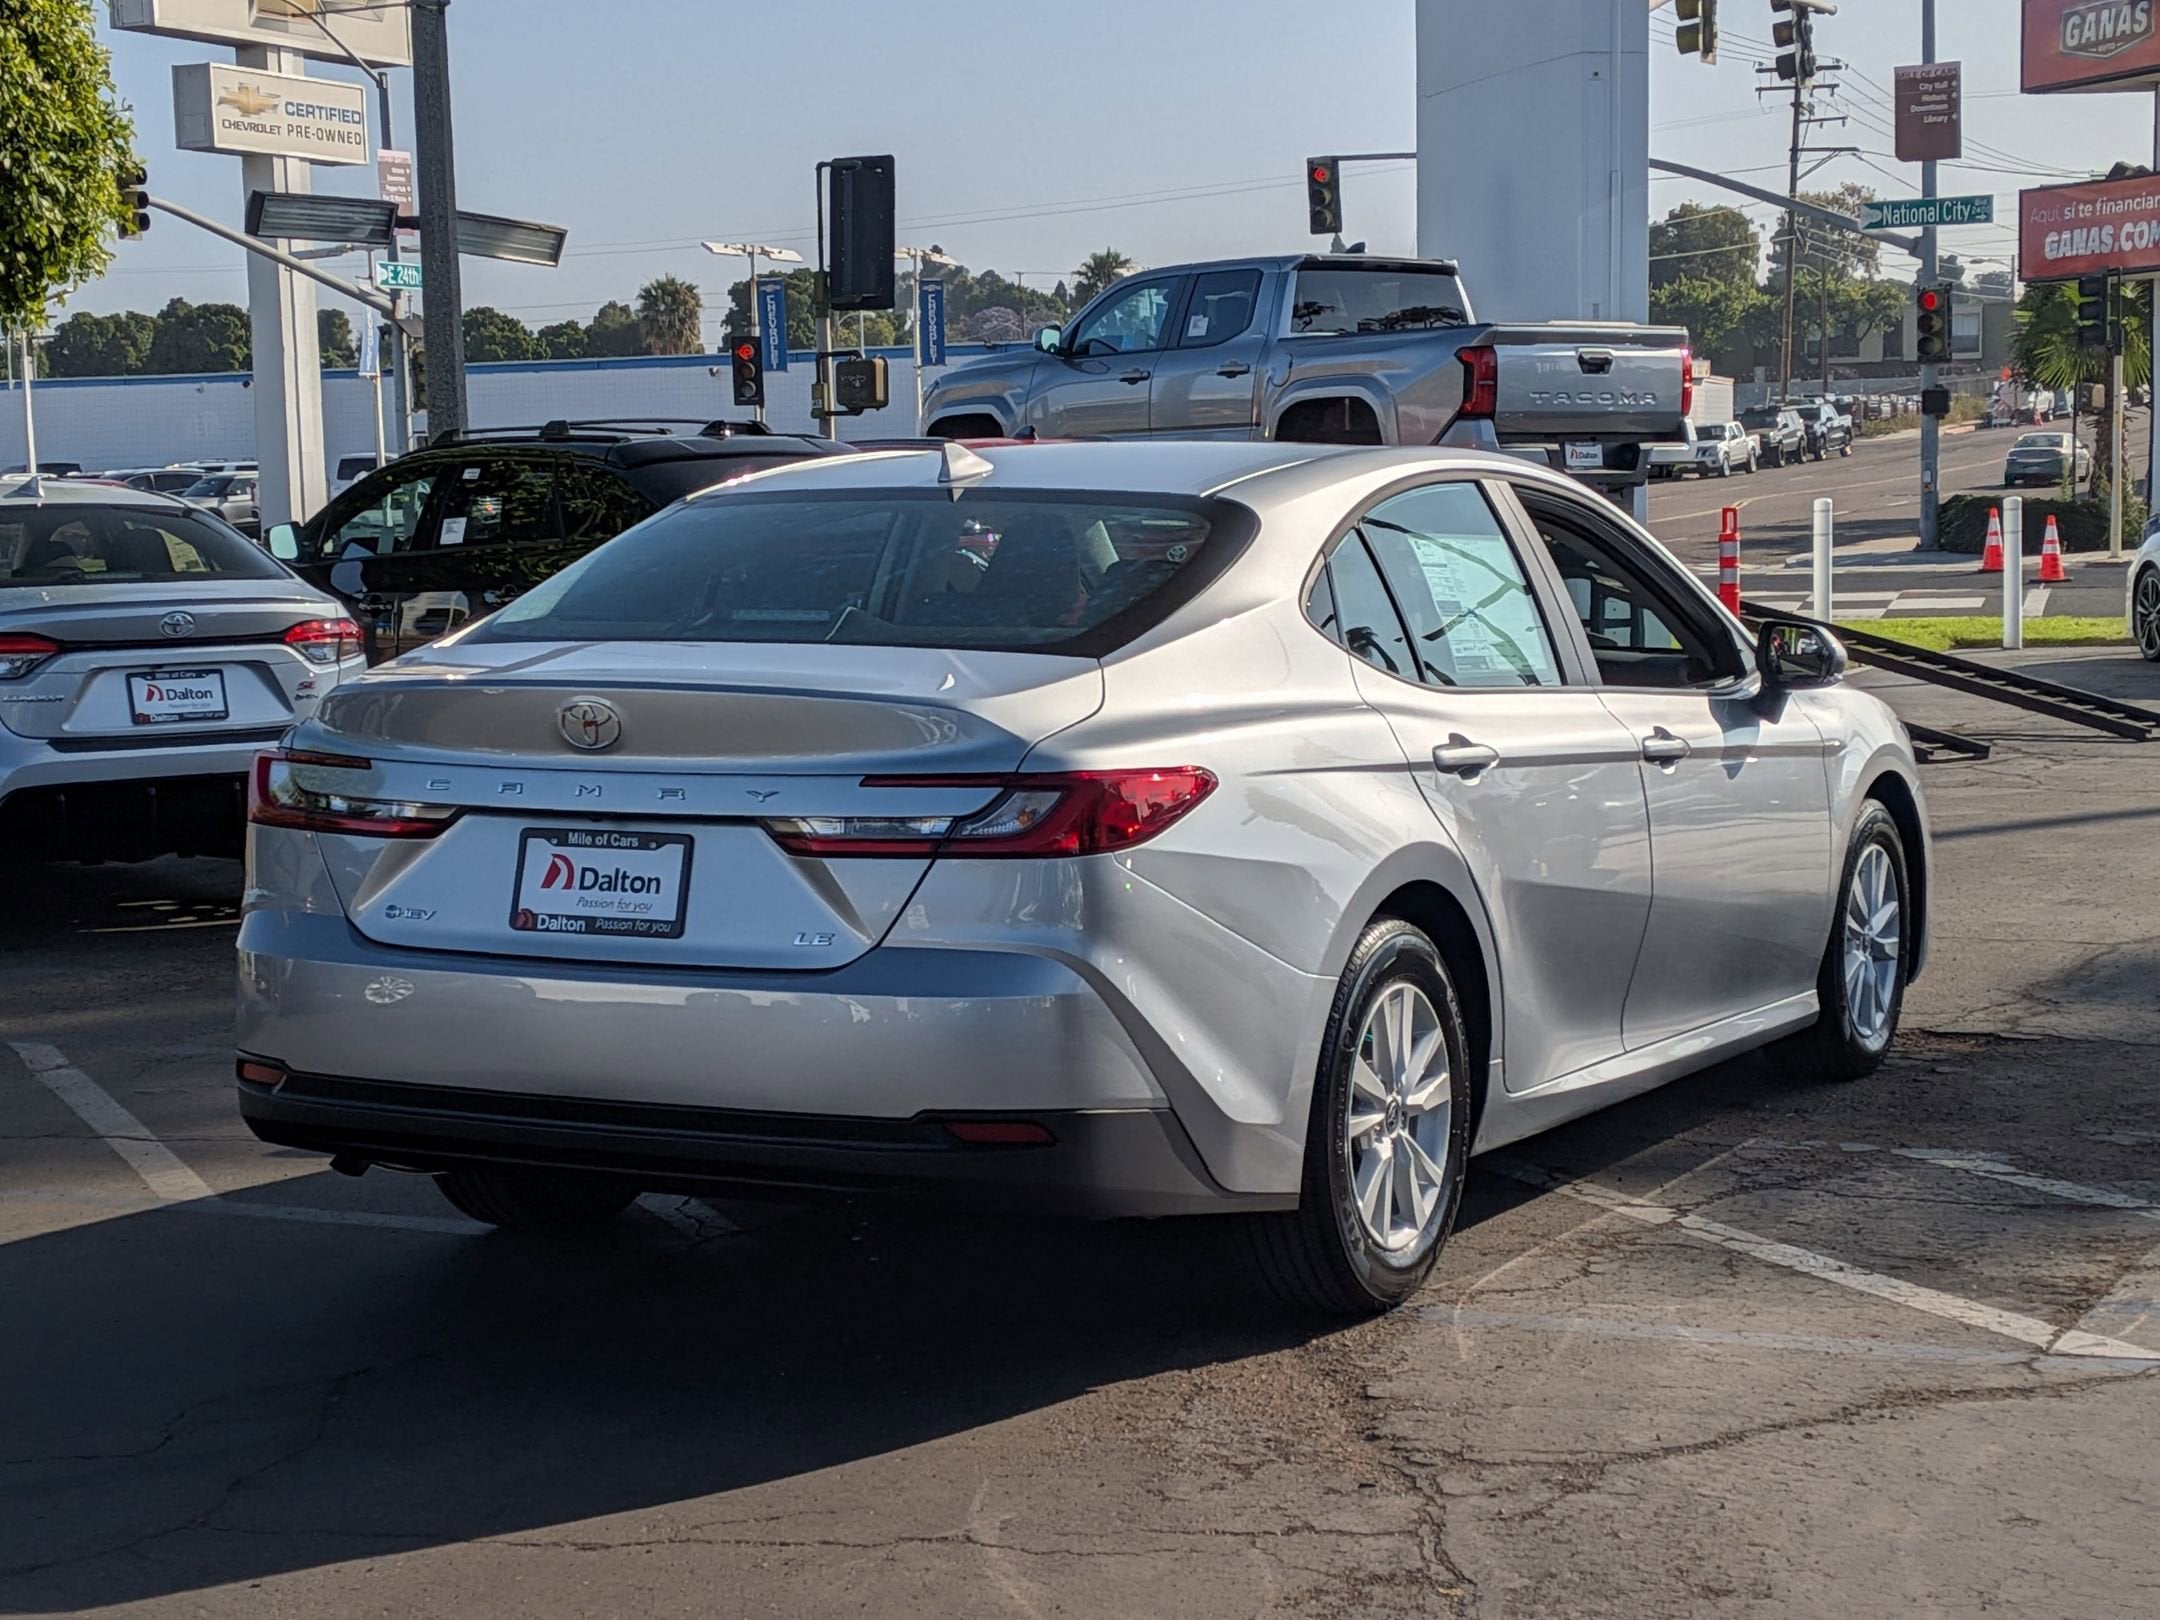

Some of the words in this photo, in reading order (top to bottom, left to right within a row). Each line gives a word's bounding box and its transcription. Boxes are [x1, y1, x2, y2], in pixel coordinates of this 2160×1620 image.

[2065, 1, 2150, 47] GANAS
[1919, 83, 1933, 92] City
[284, 101, 361, 125] CERTIFIED
[222, 119, 281, 136] CHEVROLET
[287, 124, 362, 146] PRE-OWNED
[1882, 201, 1940, 226] National
[1943, 200, 1971, 221] City
[2064, 202, 2076, 220] sí
[2079, 202, 2093, 218] te
[2044, 219, 2160, 260] GANAS.COM
[387, 266, 395, 284] E
[1529, 391, 1657, 405] TACOMA
[166, 687, 213, 701] Dalton
[426, 778, 780, 803] CAMRY
[568, 832, 592, 846] Mile
[595, 833, 609, 846] of
[610, 833, 639, 847] Cars
[578, 866, 661, 894] Dalton
[576, 896, 614, 909] Passion
[616, 898, 631, 911] for
[632, 901, 653, 912] you
[537, 914, 586, 932] Dalton
[595, 918, 633, 931] Passion
[633, 919, 650, 932] for
[650, 922, 671, 933] you
[793, 931, 836, 946] LE
